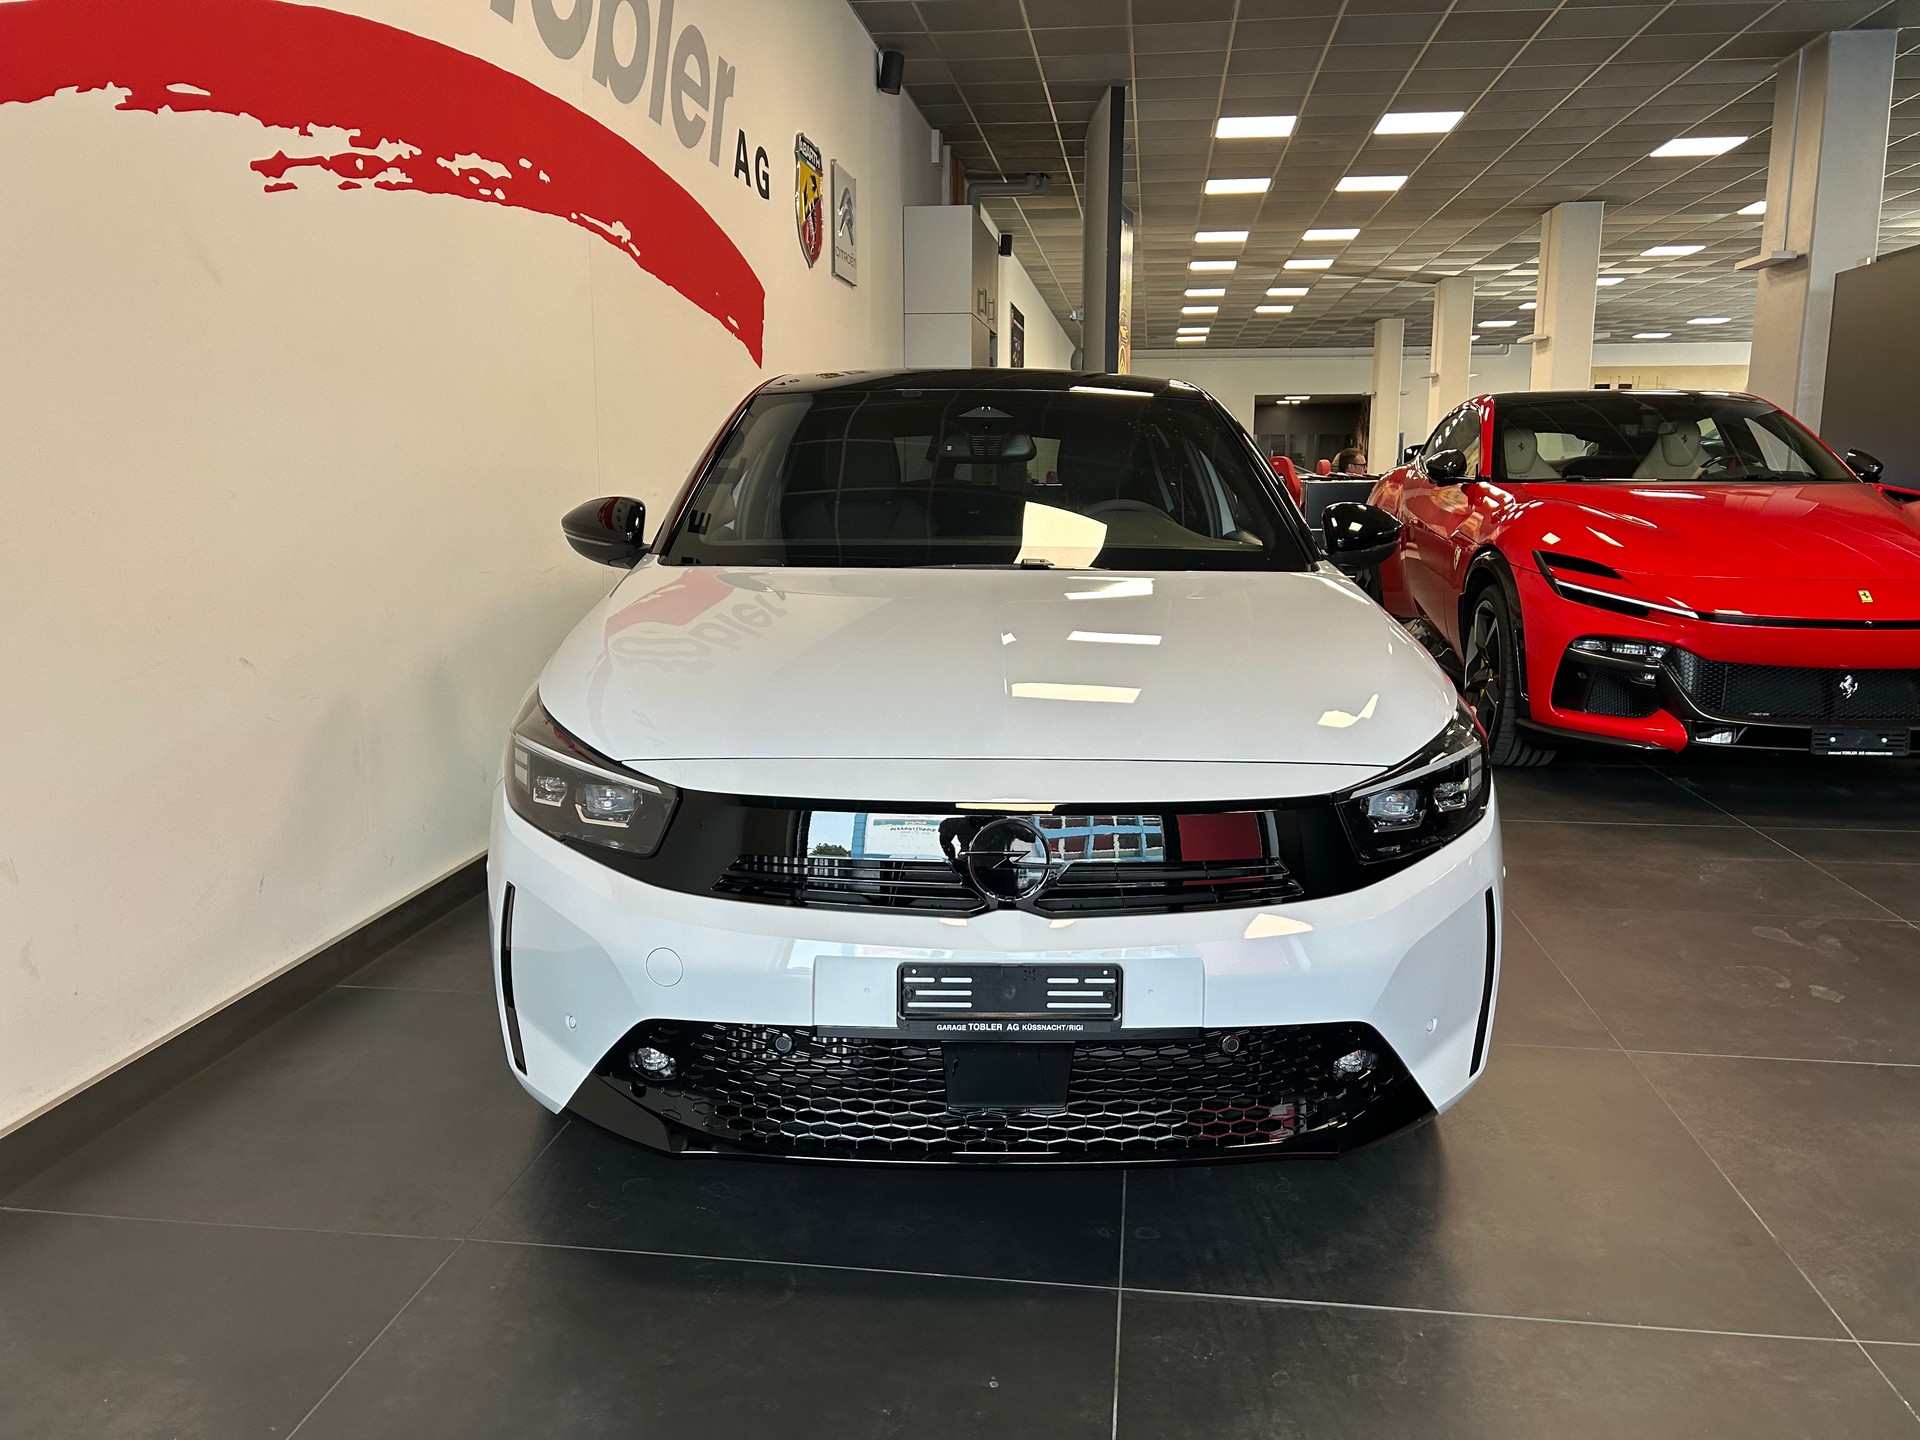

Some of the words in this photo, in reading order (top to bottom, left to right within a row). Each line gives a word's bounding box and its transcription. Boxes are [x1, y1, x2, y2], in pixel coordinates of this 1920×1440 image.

[733, 128, 770, 200] AG
[968, 1023, 1003, 1031] TOBLER
[1006, 1023, 1020, 1031] AG
[1021, 1023, 1084, 1031] KÜSSNACHT/RIGI
